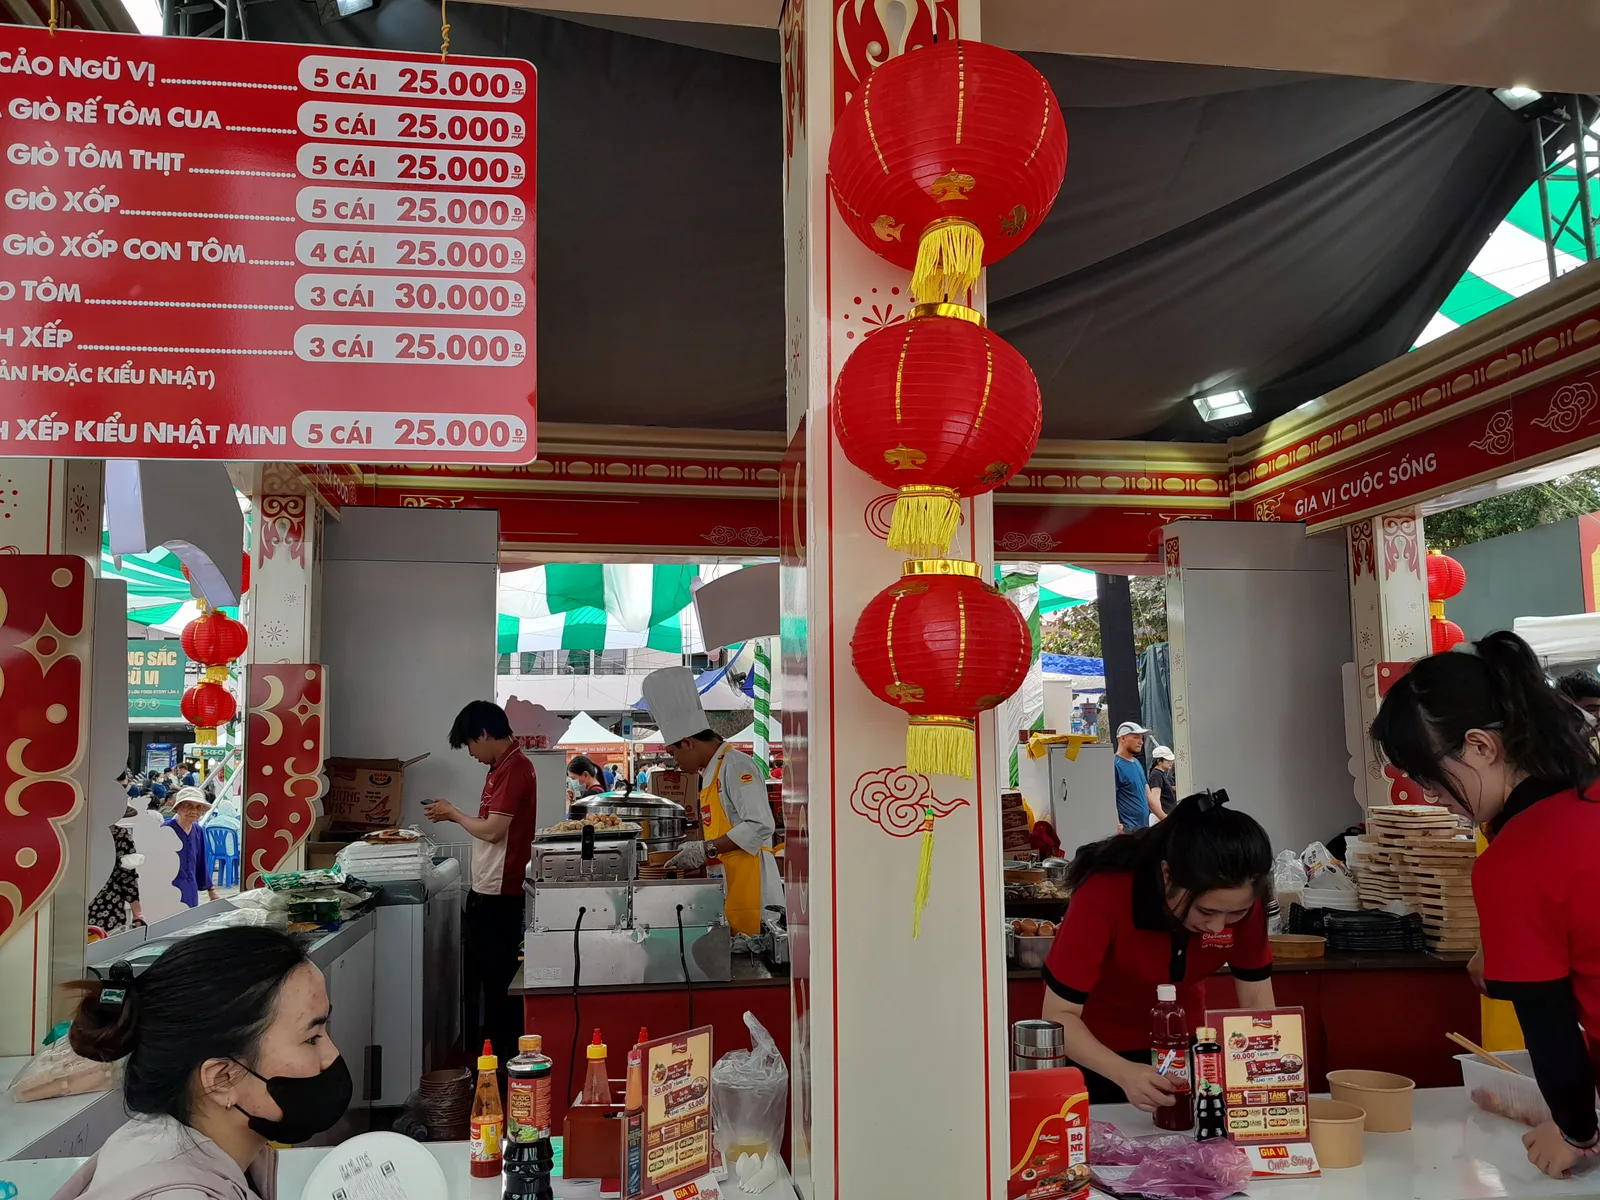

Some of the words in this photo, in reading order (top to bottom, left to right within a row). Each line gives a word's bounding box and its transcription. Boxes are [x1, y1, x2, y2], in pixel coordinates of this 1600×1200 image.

[0, 47, 53, 76] CẢO
[59, 56, 121, 80] NGŨ
[127, 61, 155, 87] VỊ
[314, 68, 329, 88] 5
[335, 67, 377, 90] CÁI
[398, 68, 510, 98] 25.000
[8, 96, 60, 121] GIÒ
[66, 96, 102, 123] RẾ
[104, 100, 161, 126] TÔM
[167, 107, 222, 129] CUA
[313, 114, 328, 133] 5
[335, 112, 376, 136] CÁI
[397, 113, 510, 143] 25.000
[7, 141, 59, 166] GIÒ
[64, 143, 123, 169] TÔM
[129, 149, 185, 176] THỊT
[312, 156, 327, 175] 5
[334, 154, 375, 177] CÁI
[397, 154, 509, 183] 25.000
[5, 185, 57, 211] GIÒ
[62, 184, 120, 213] XỐP
[312, 199, 327, 219] 5
[334, 197, 375, 220] CÁI
[396, 197, 509, 226] 25.000
[3, 231, 55, 256] GIÒ
[60, 229, 117, 258] XỐP
[123, 238, 181, 260] CON
[187, 237, 246, 263] TÔM
[310, 243, 326, 261] 4
[334, 241, 375, 264] CÁI
[396, 240, 509, 268] 25.000
[21, 276, 81, 303] TÔM
[310, 287, 326, 306] 3
[333, 284, 374, 307] CÁI
[395, 283, 509, 312] 30.000
[20, 319, 73, 348] XẾP
[309, 337, 325, 357] 3
[332, 334, 373, 358] CÁI
[395, 333, 509, 361] 25.000
[32, 362, 92, 386] HOẶC
[97, 360, 145, 384] KIỂU
[150, 366, 215, 390] NHẬT)
[15, 412, 69, 441] XẾP
[74, 412, 137, 442] KIỂU
[143, 418, 220, 449] NHẬT
[225, 424, 287, 445] MINI
[308, 424, 323, 444] 5
[330, 420, 372, 444] CÁI
[394, 419, 510, 447] 25.000
[1295, 495, 1318, 516] GIA
[1322, 488, 1336, 508] VỊ
[1340, 471, 1384, 500] CUỘC
[1389, 453, 1437, 485] SỐNG
[147, 645, 177, 666] SẮC
[144, 670, 160, 688] VỊ
[1070, 1132, 1083, 1142] BÒ
[1070, 1142, 1084, 1153] NÉ
[1260, 1148, 1276, 1157] GIA
[1277, 1148, 1287, 1157] VỊ
[675, 1189, 688, 1199] GIA
[689, 1185, 698, 1194] VỊ
